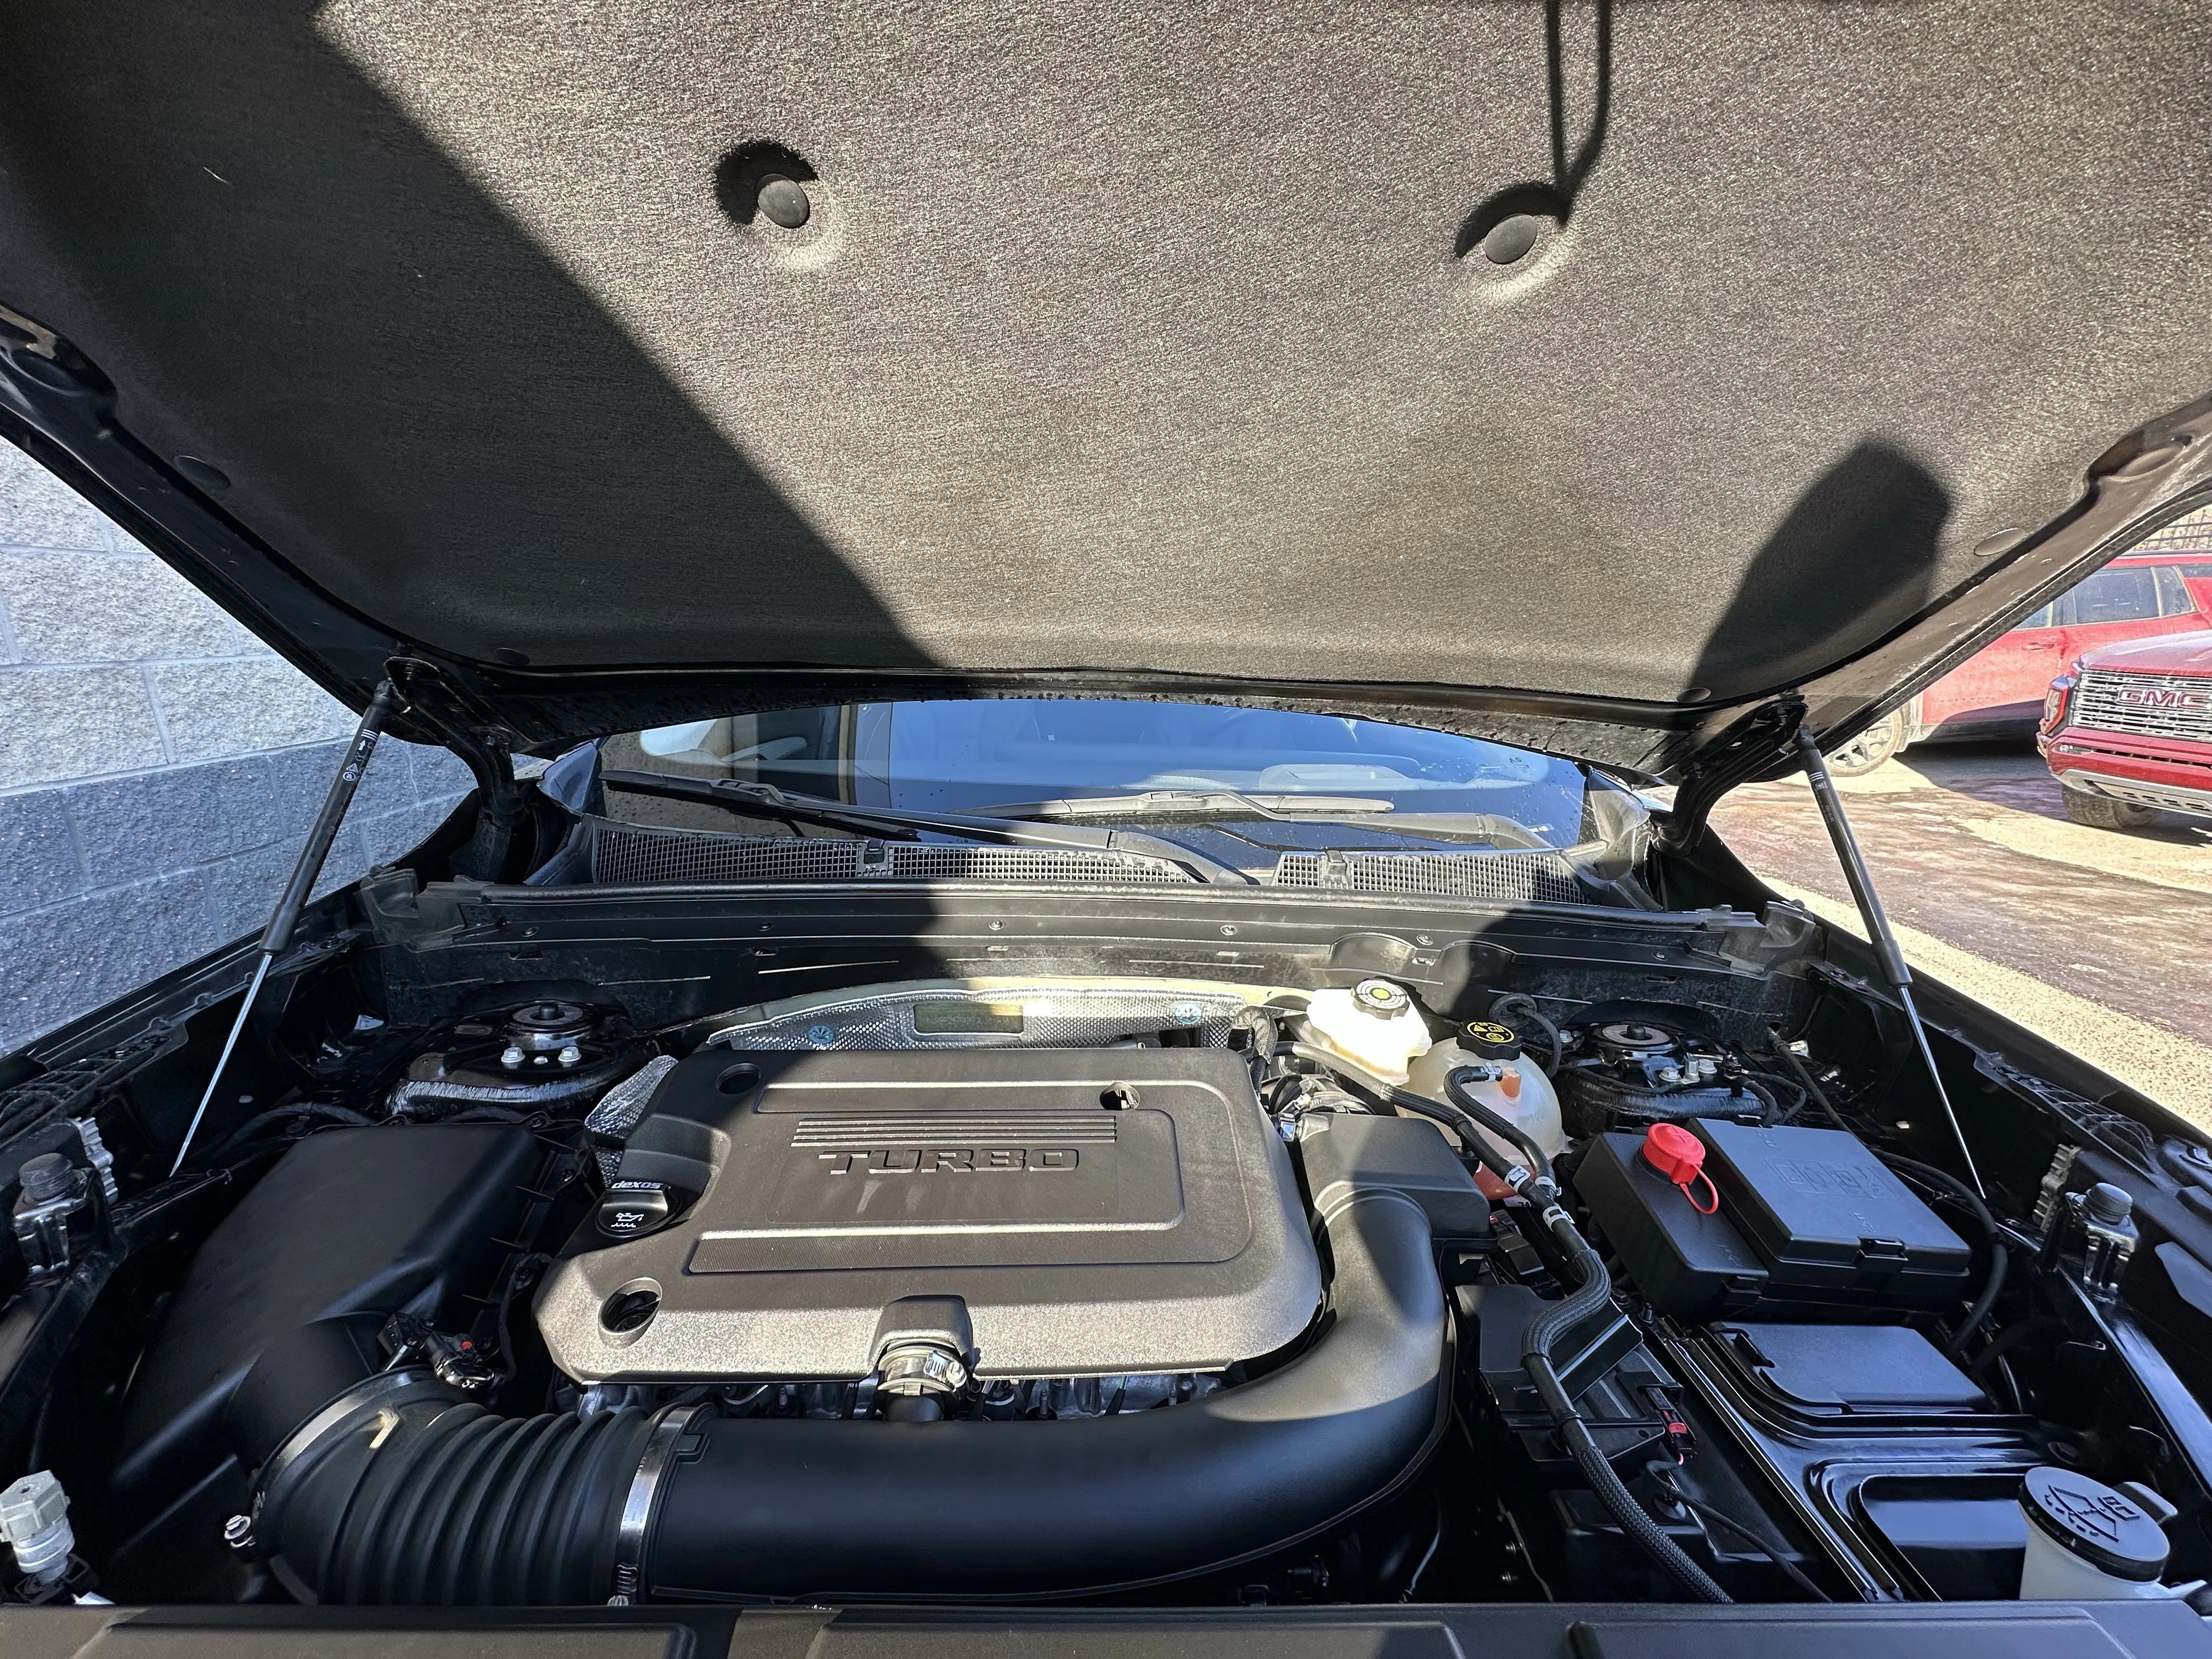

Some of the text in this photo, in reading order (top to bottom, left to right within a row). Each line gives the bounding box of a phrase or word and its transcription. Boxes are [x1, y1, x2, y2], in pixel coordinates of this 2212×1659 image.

[2116, 687, 2212, 710] GMC
[818, 1149, 1080, 1175] TURBO
[611, 1180, 664, 1189] dexos
